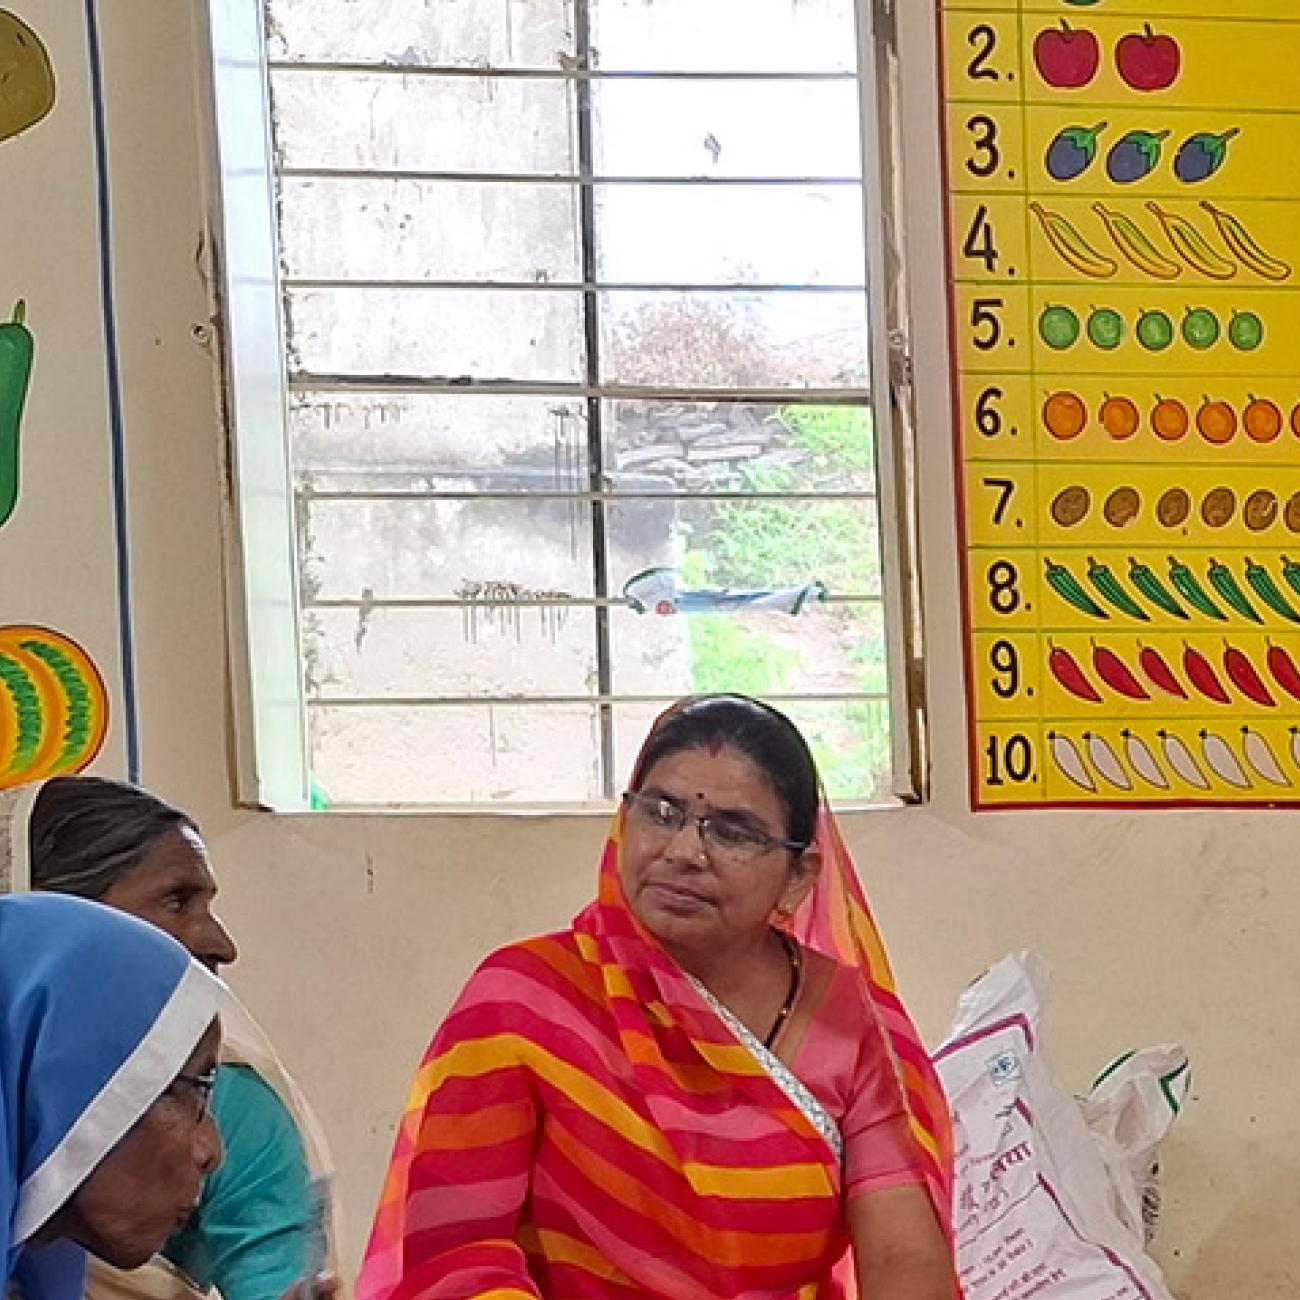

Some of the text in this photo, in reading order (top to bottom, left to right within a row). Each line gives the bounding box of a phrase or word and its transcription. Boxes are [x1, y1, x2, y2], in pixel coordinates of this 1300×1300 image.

[967, 25, 1014, 81] 2.
[966, 116, 1015, 180] 3.
[963, 206, 1016, 276] 4.
[970, 299, 1016, 350] 5.
[975, 387, 1017, 437] 6.
[983, 478, 1023, 528] 7.
[987, 560, 1031, 614] 8.
[991, 640, 1034, 698] 9.
[986, 735, 1037, 785] 10.
